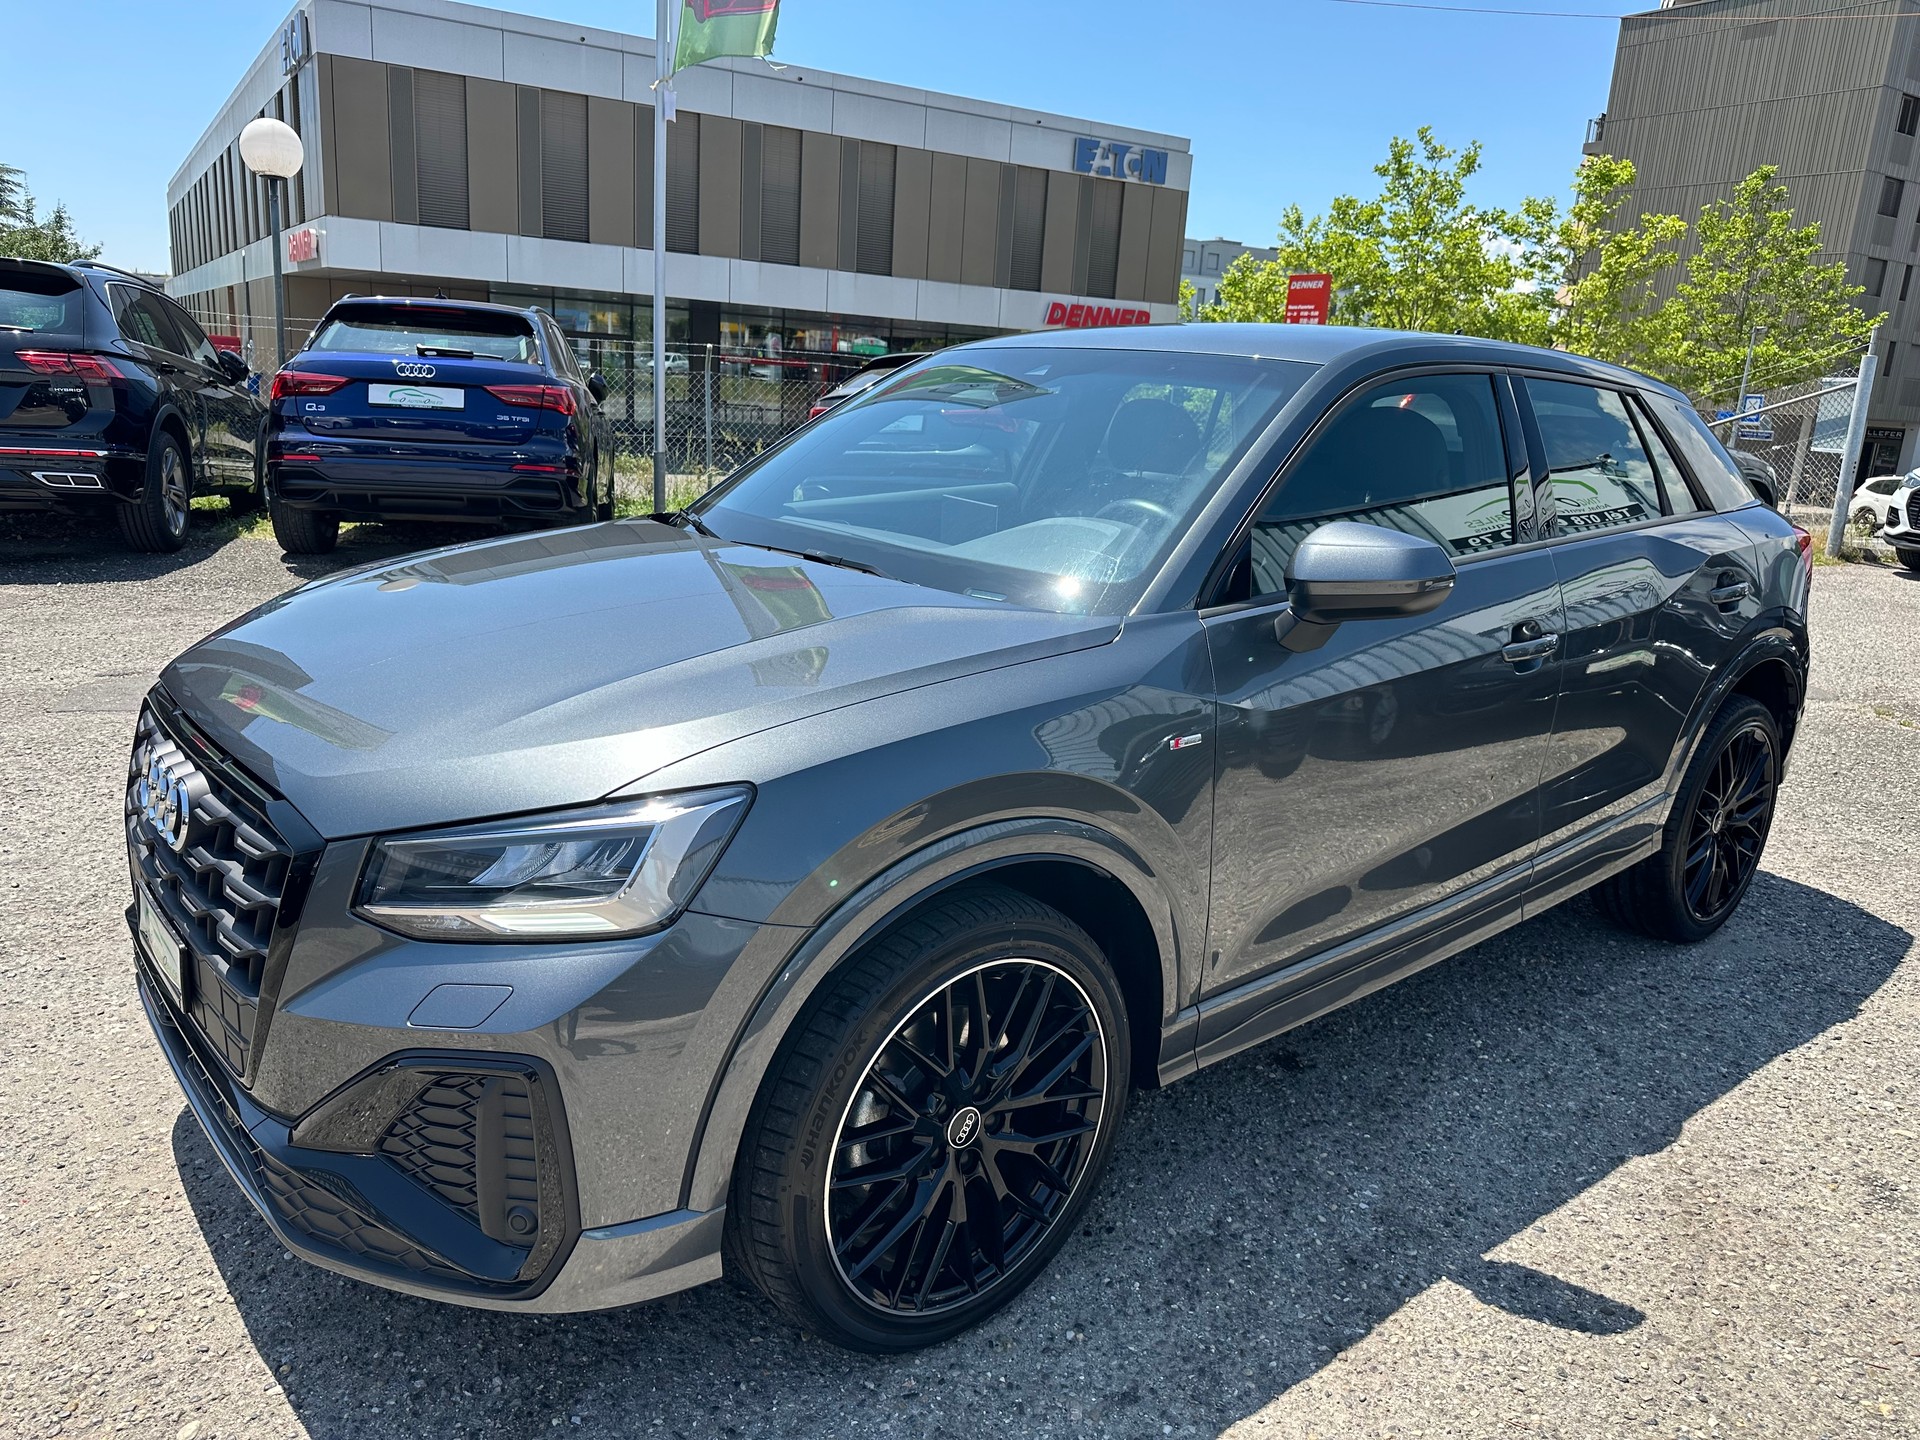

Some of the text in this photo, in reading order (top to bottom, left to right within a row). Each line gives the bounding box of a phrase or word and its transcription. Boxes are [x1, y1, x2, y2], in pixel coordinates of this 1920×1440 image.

[1074, 137, 1169, 185] EATON
[1290, 280, 1325, 290] DENNER
[305, 402, 326, 411] Q3
[511, 415, 530, 423] TFSI
